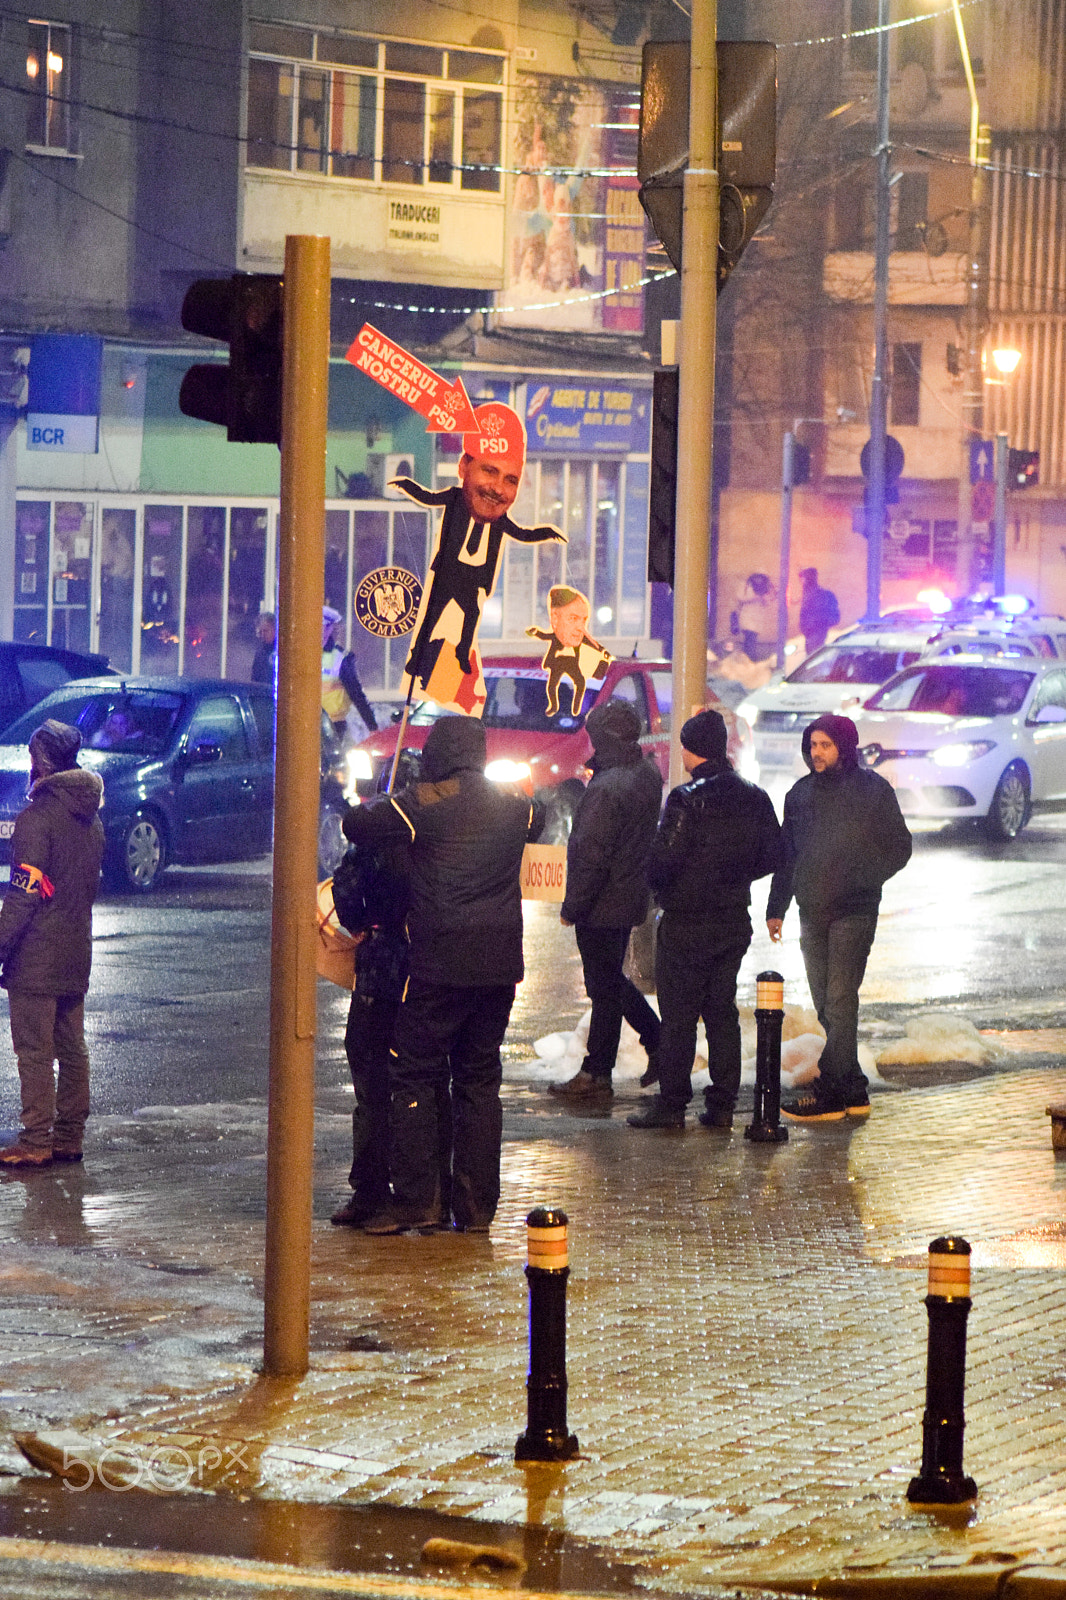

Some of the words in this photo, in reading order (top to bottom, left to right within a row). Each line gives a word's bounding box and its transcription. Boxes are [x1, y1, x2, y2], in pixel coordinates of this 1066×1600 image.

[391, 202, 440, 224] TRADUCERI
[358, 330, 439, 398] CANCERUL
[357, 351, 422, 404] NOSTRU
[428, 404, 457, 431] PSD
[31, 427, 65, 445] BCR
[479, 438, 509, 454] PSD
[359, 570, 418, 598] GUVERNUL
[525, 862, 543, 887] JOS
[544, 862, 563, 887] OUG
